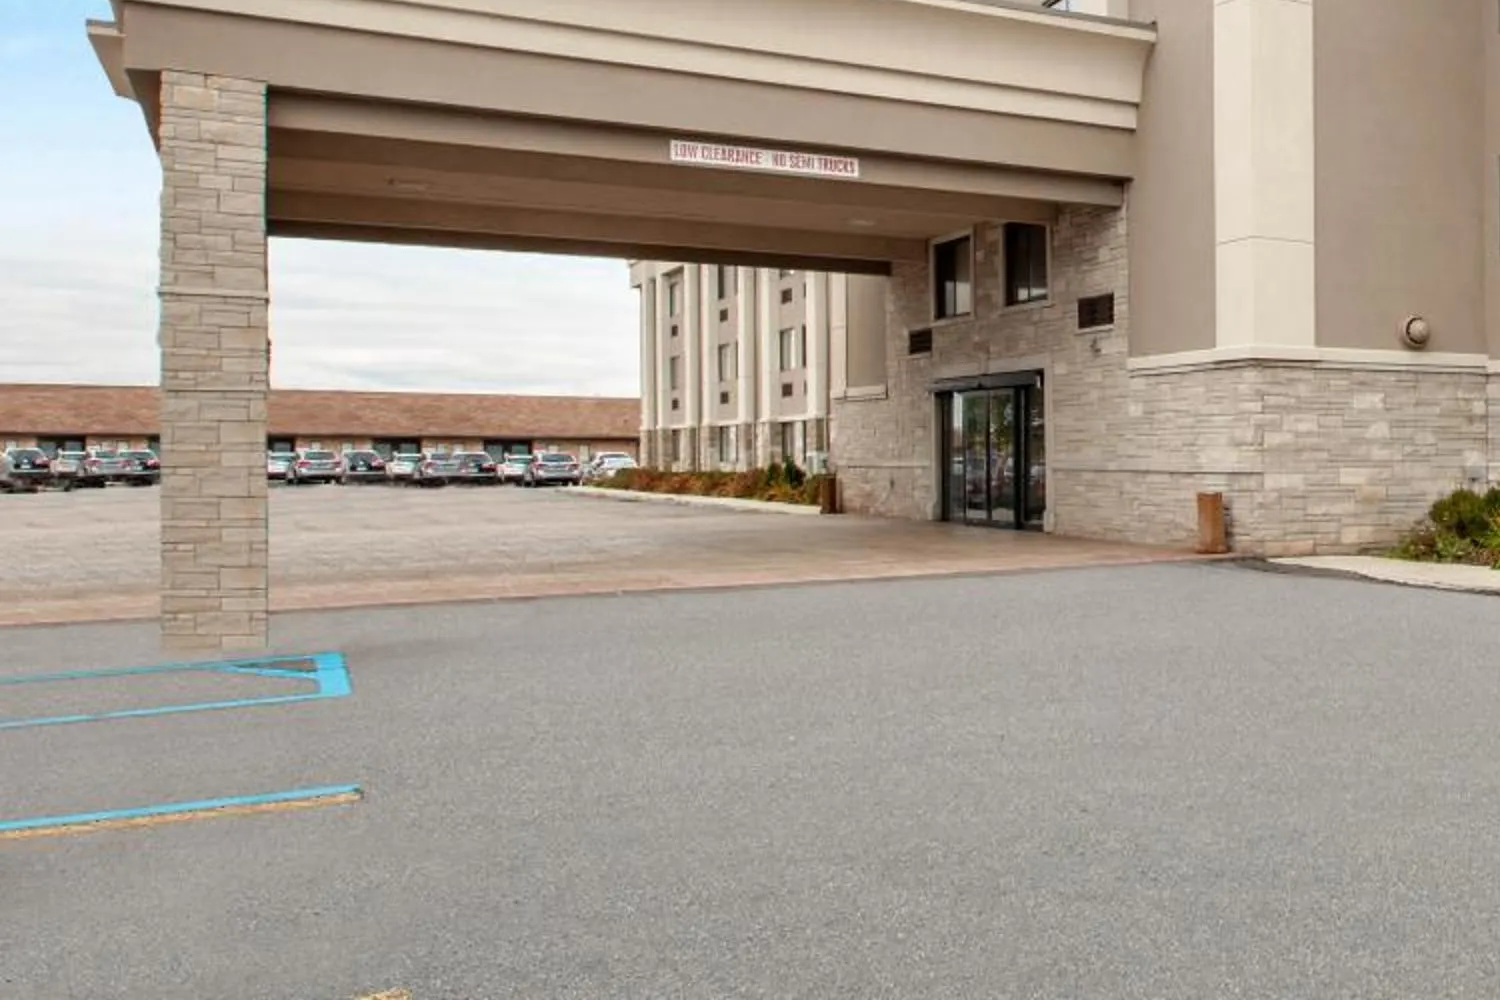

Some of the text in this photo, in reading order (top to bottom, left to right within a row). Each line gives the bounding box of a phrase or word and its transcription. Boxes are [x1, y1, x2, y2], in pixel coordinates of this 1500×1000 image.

[674, 143, 855, 174] LOW CLEARANCE NO SEMI TRUCKS
